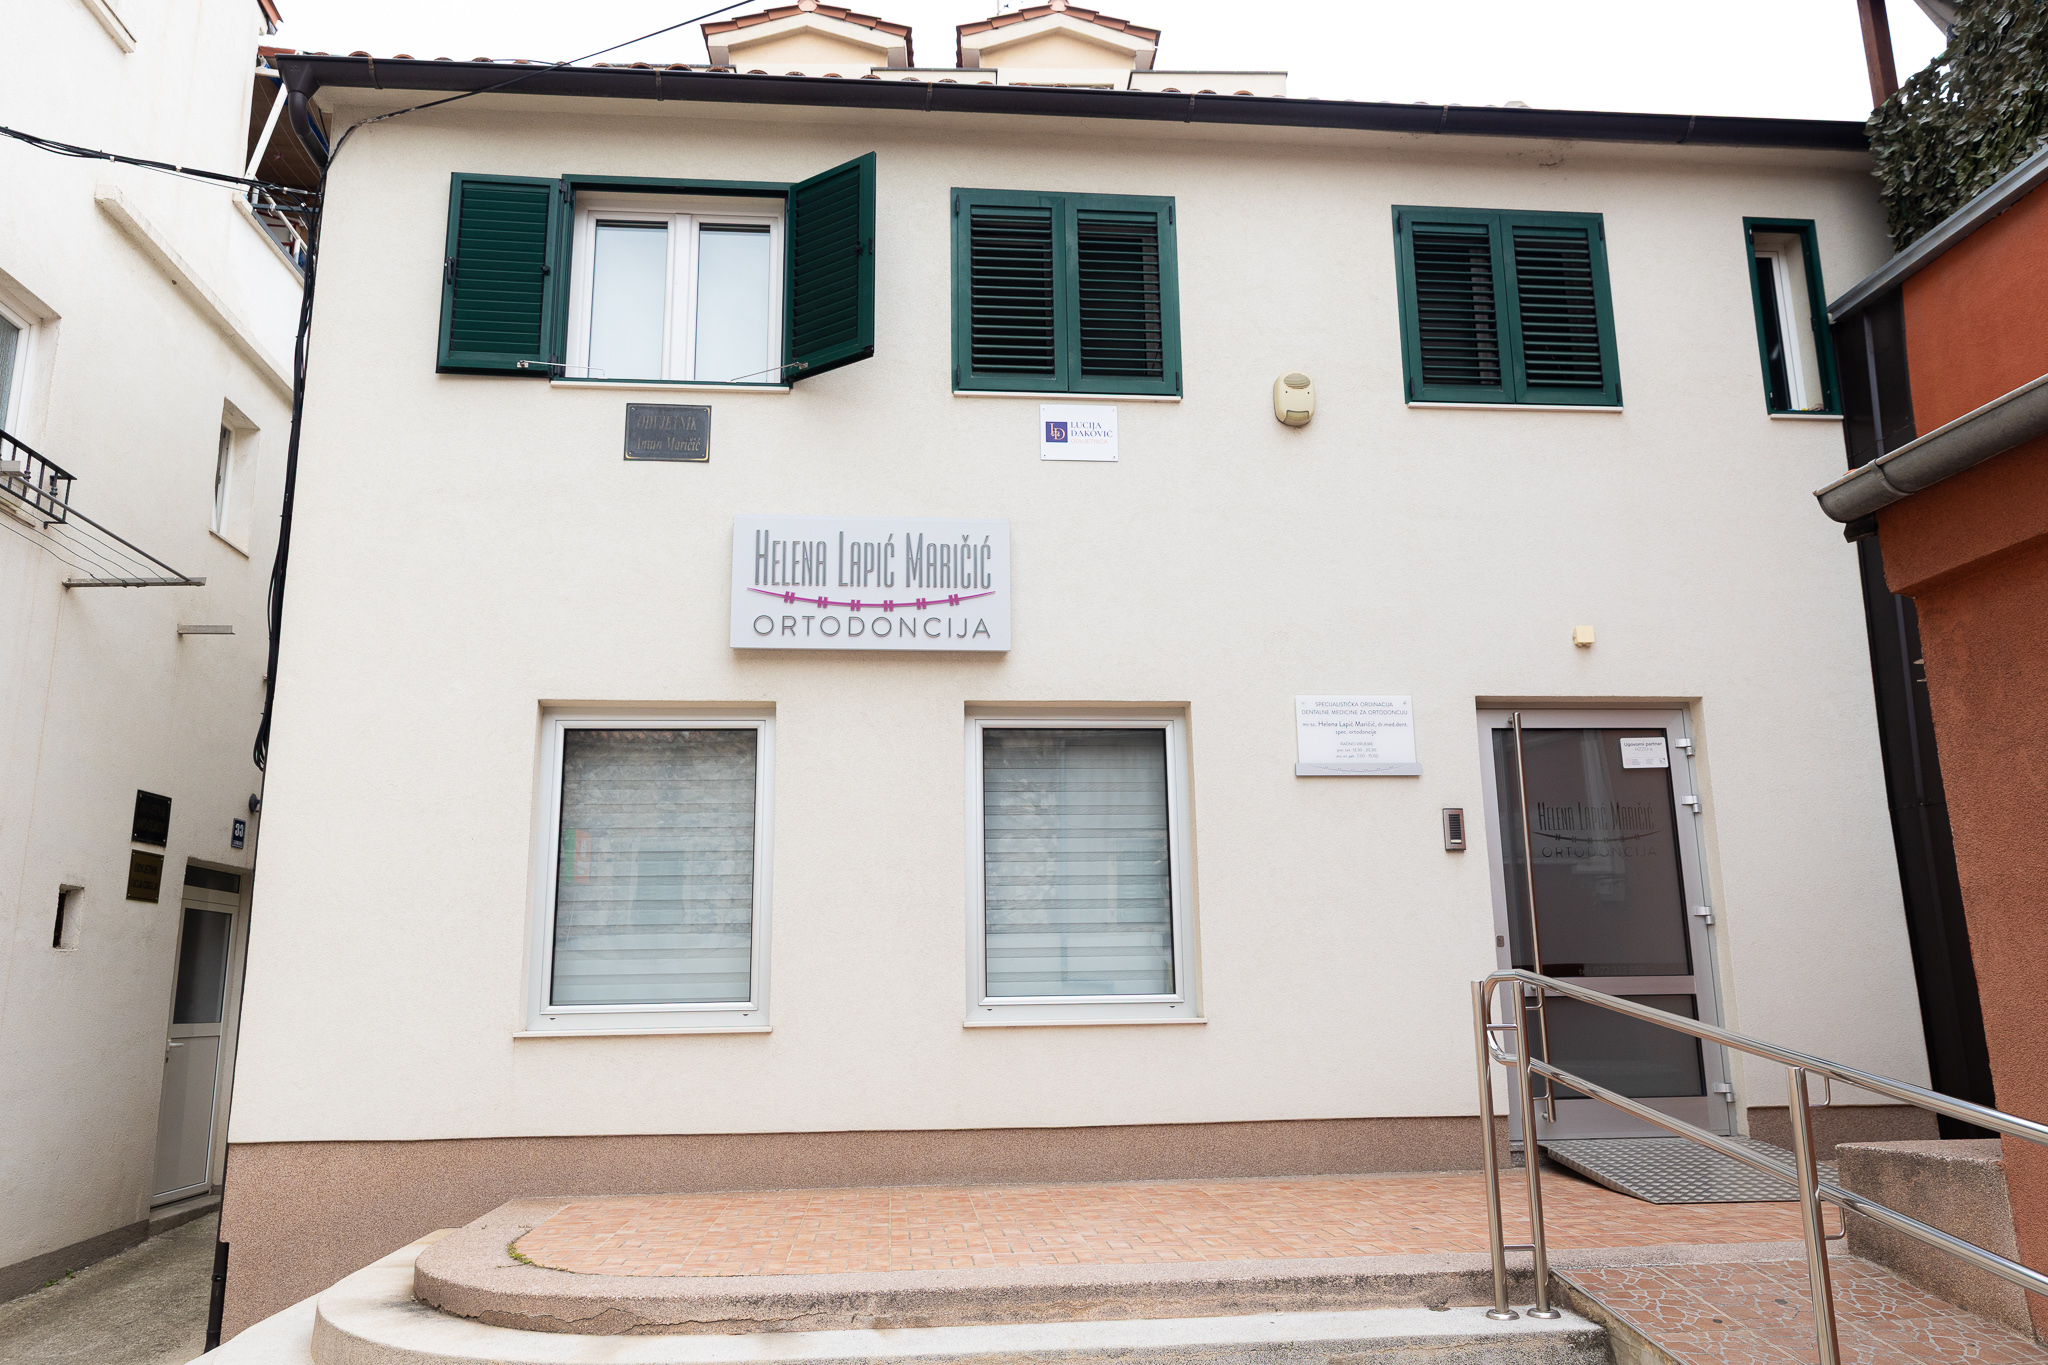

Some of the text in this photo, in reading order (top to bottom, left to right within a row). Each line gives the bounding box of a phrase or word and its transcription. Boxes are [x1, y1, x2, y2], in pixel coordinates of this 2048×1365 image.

[1070, 421, 1102, 430] LUCIJA
[754, 529, 992, 589] HELENA LAPIĆ MARIČIĆ
[753, 614, 991, 638] ORTODONCIJA
[1537, 802, 1575, 831] HELENA
[234, 823, 244, 838] 33
[1542, 847, 1657, 858] ORTODONCIJA
